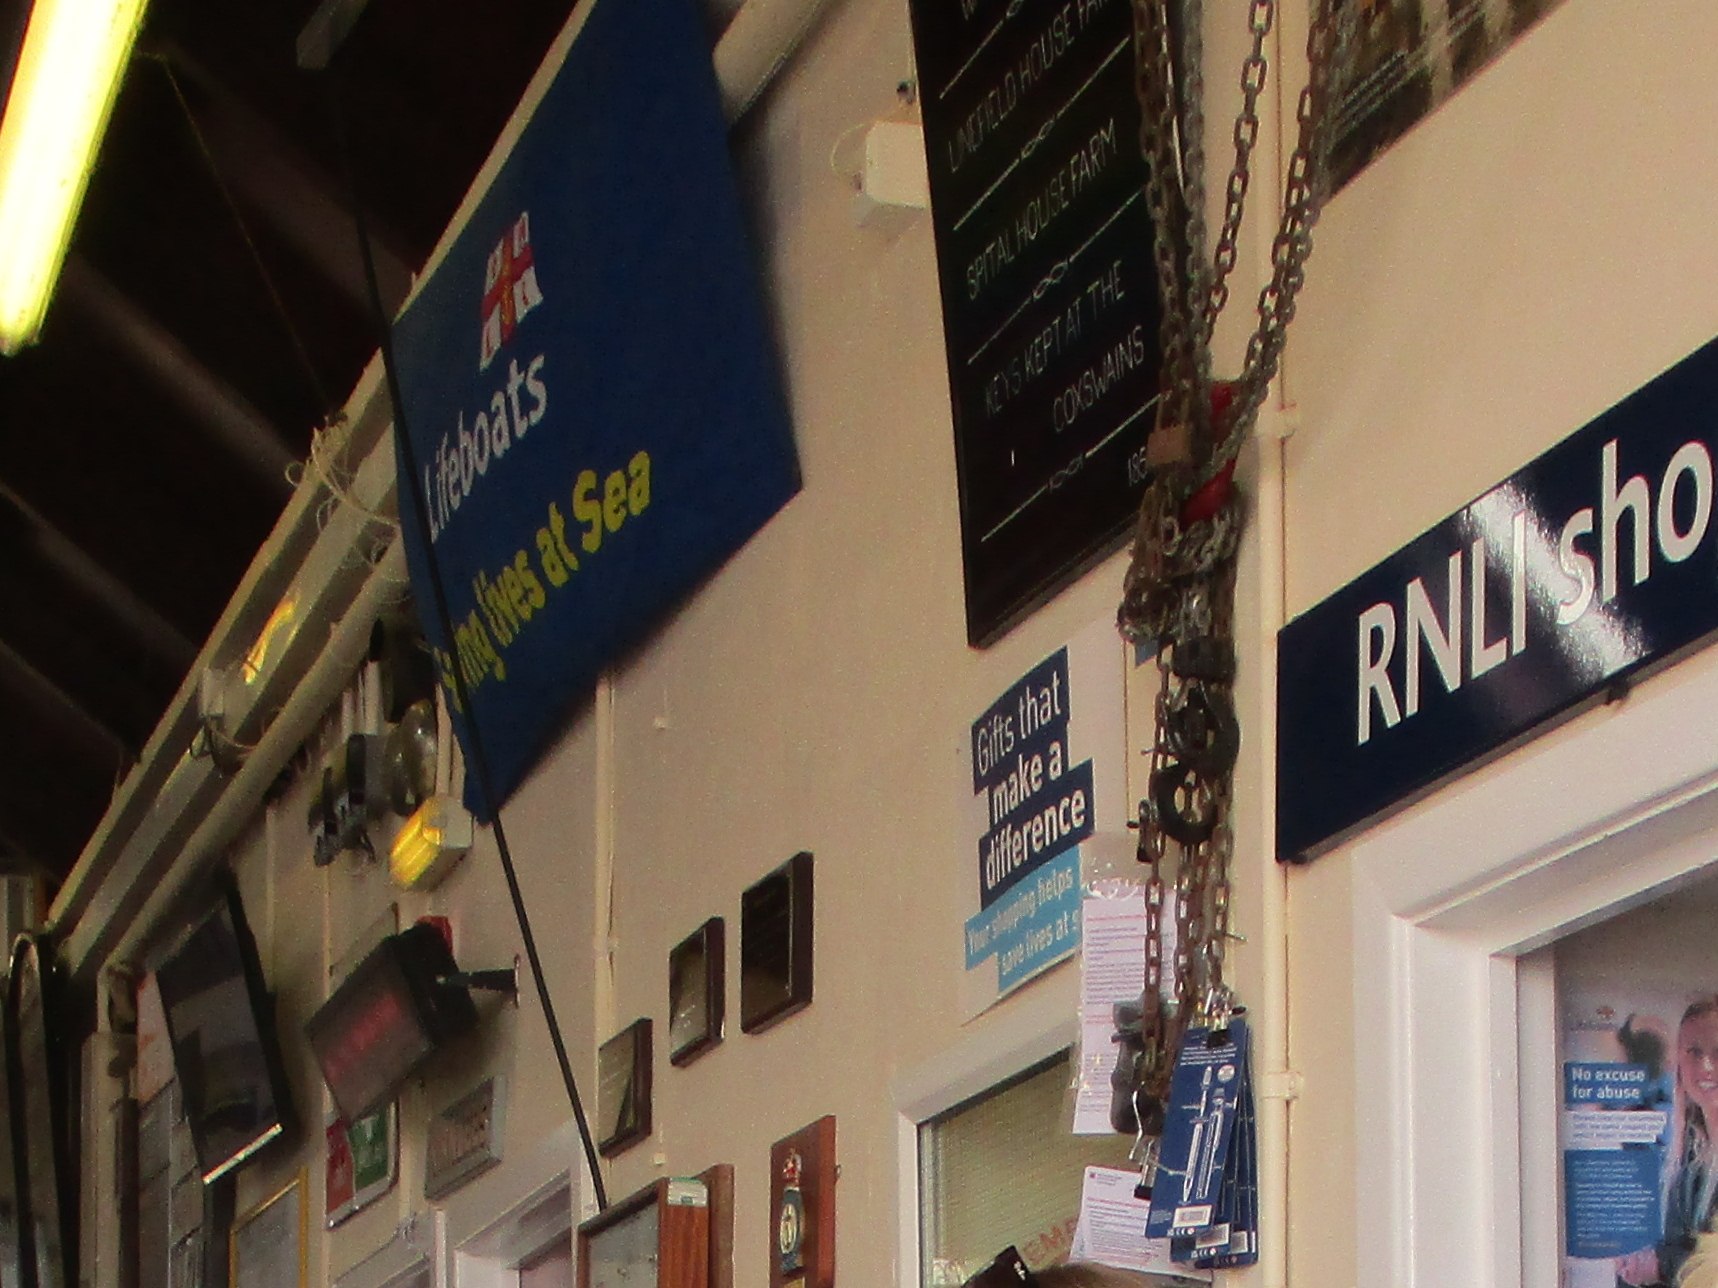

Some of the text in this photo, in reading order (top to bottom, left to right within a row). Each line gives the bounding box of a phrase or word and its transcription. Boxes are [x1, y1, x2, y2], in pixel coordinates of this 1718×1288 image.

[1019, 3, 1075, 94] HOUSE
[967, 119, 1117, 300] SPITAL HOUSE FARM
[1024, 315, 1061, 382] KEPT
[1087, 260, 1125, 320] THE
[1053, 325, 1145, 433] COXSWAINS
[424, 353, 546, 543] Lifeboats
[535, 502, 579, 588] at
[573, 450, 652, 555] Sea
[1358, 510, 1528, 746] RNLI
[977, 669, 1062, 777] Gifts that
[992, 739, 1063, 822] make a
[985, 787, 1086, 890] difference
[1572, 1068, 1646, 1084] No excuse
[1572, 1085, 1641, 1100] for abuse
